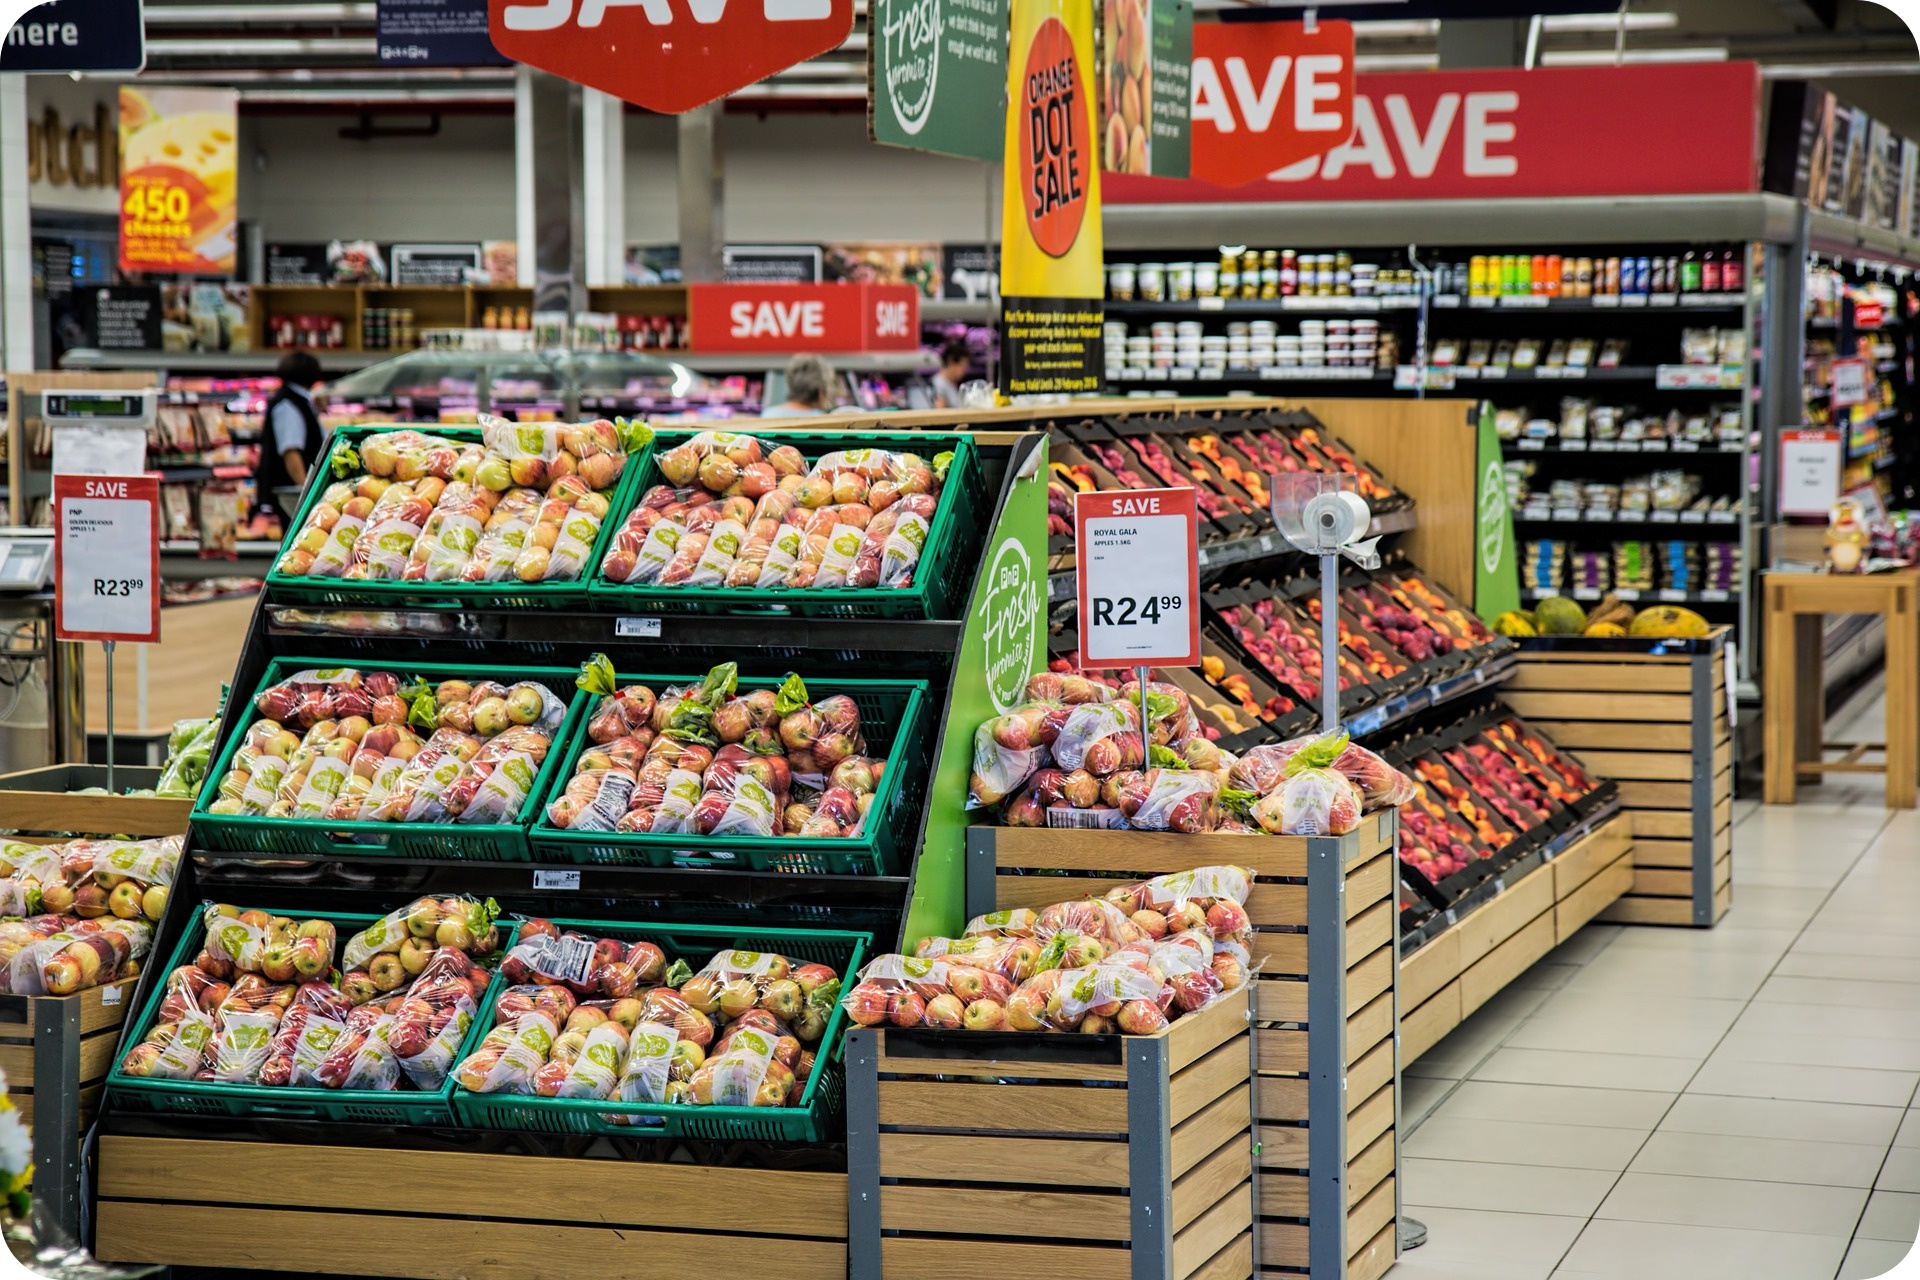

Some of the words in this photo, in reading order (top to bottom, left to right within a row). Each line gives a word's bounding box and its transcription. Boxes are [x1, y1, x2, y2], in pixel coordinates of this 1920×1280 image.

[1028, 58, 1073, 104] ORANGE
[1191, 55, 1344, 133] AVE
[1029, 91, 1075, 166] DOT
[1266, 91, 1520, 181] AVE
[124, 186, 190, 222] 450
[1033, 149, 1082, 219] SALE
[124, 220, 192, 238] cheeses
[730, 301, 825, 338] SAVE
[876, 301, 909, 338] SAVE
[85, 481, 128, 498] SAVE
[1112, 498, 1160, 515] SAVE
[979, 556, 1041, 653] Fresh
[988, 643, 1023, 699] promise
